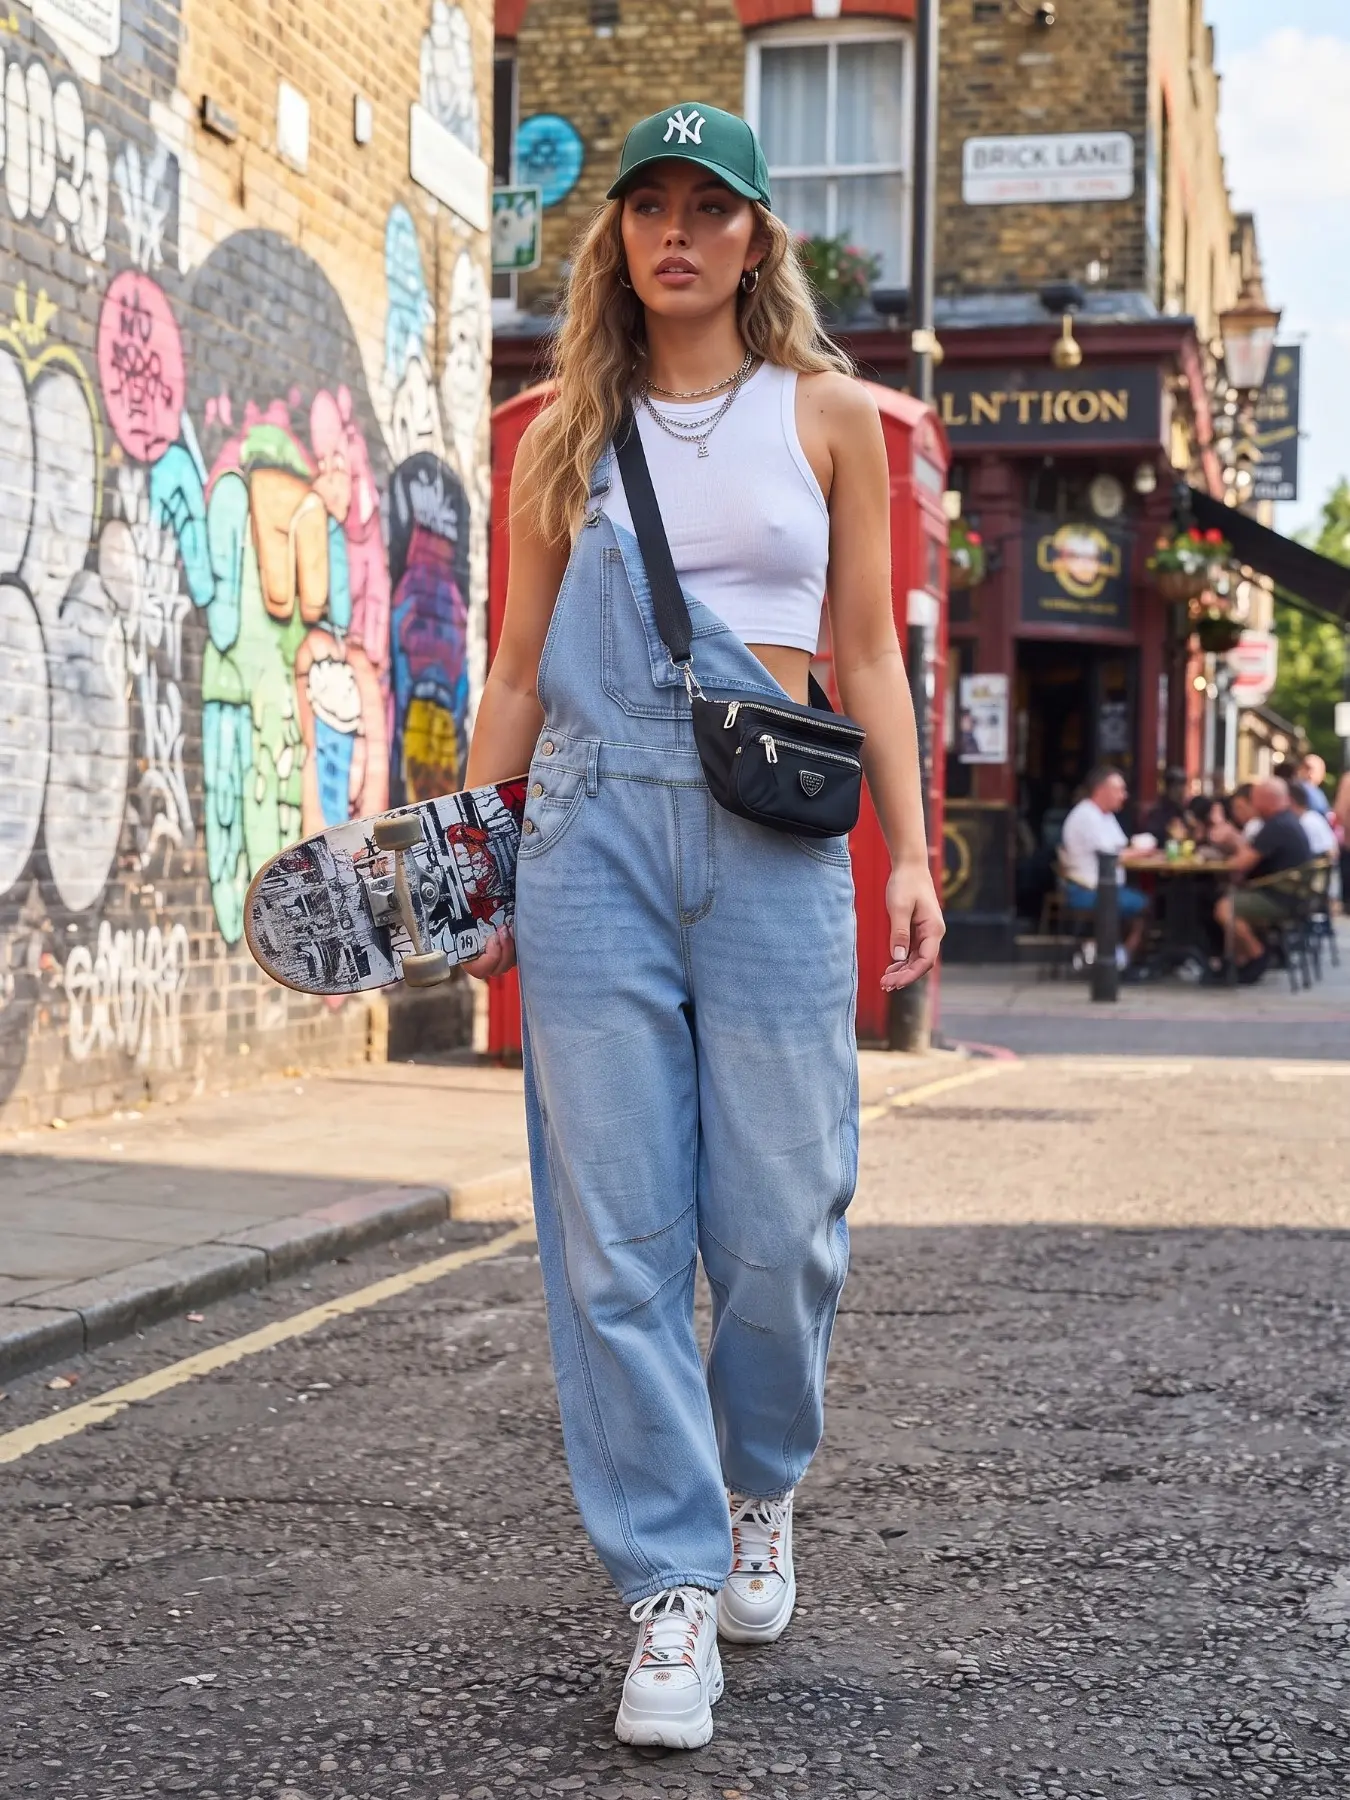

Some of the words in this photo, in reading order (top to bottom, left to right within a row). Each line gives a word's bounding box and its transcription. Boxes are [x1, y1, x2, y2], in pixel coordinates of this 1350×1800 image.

[662, 109, 706, 145] NY
[973, 143, 1050, 170] BRICK
[1056, 140, 1124, 167] LANE
